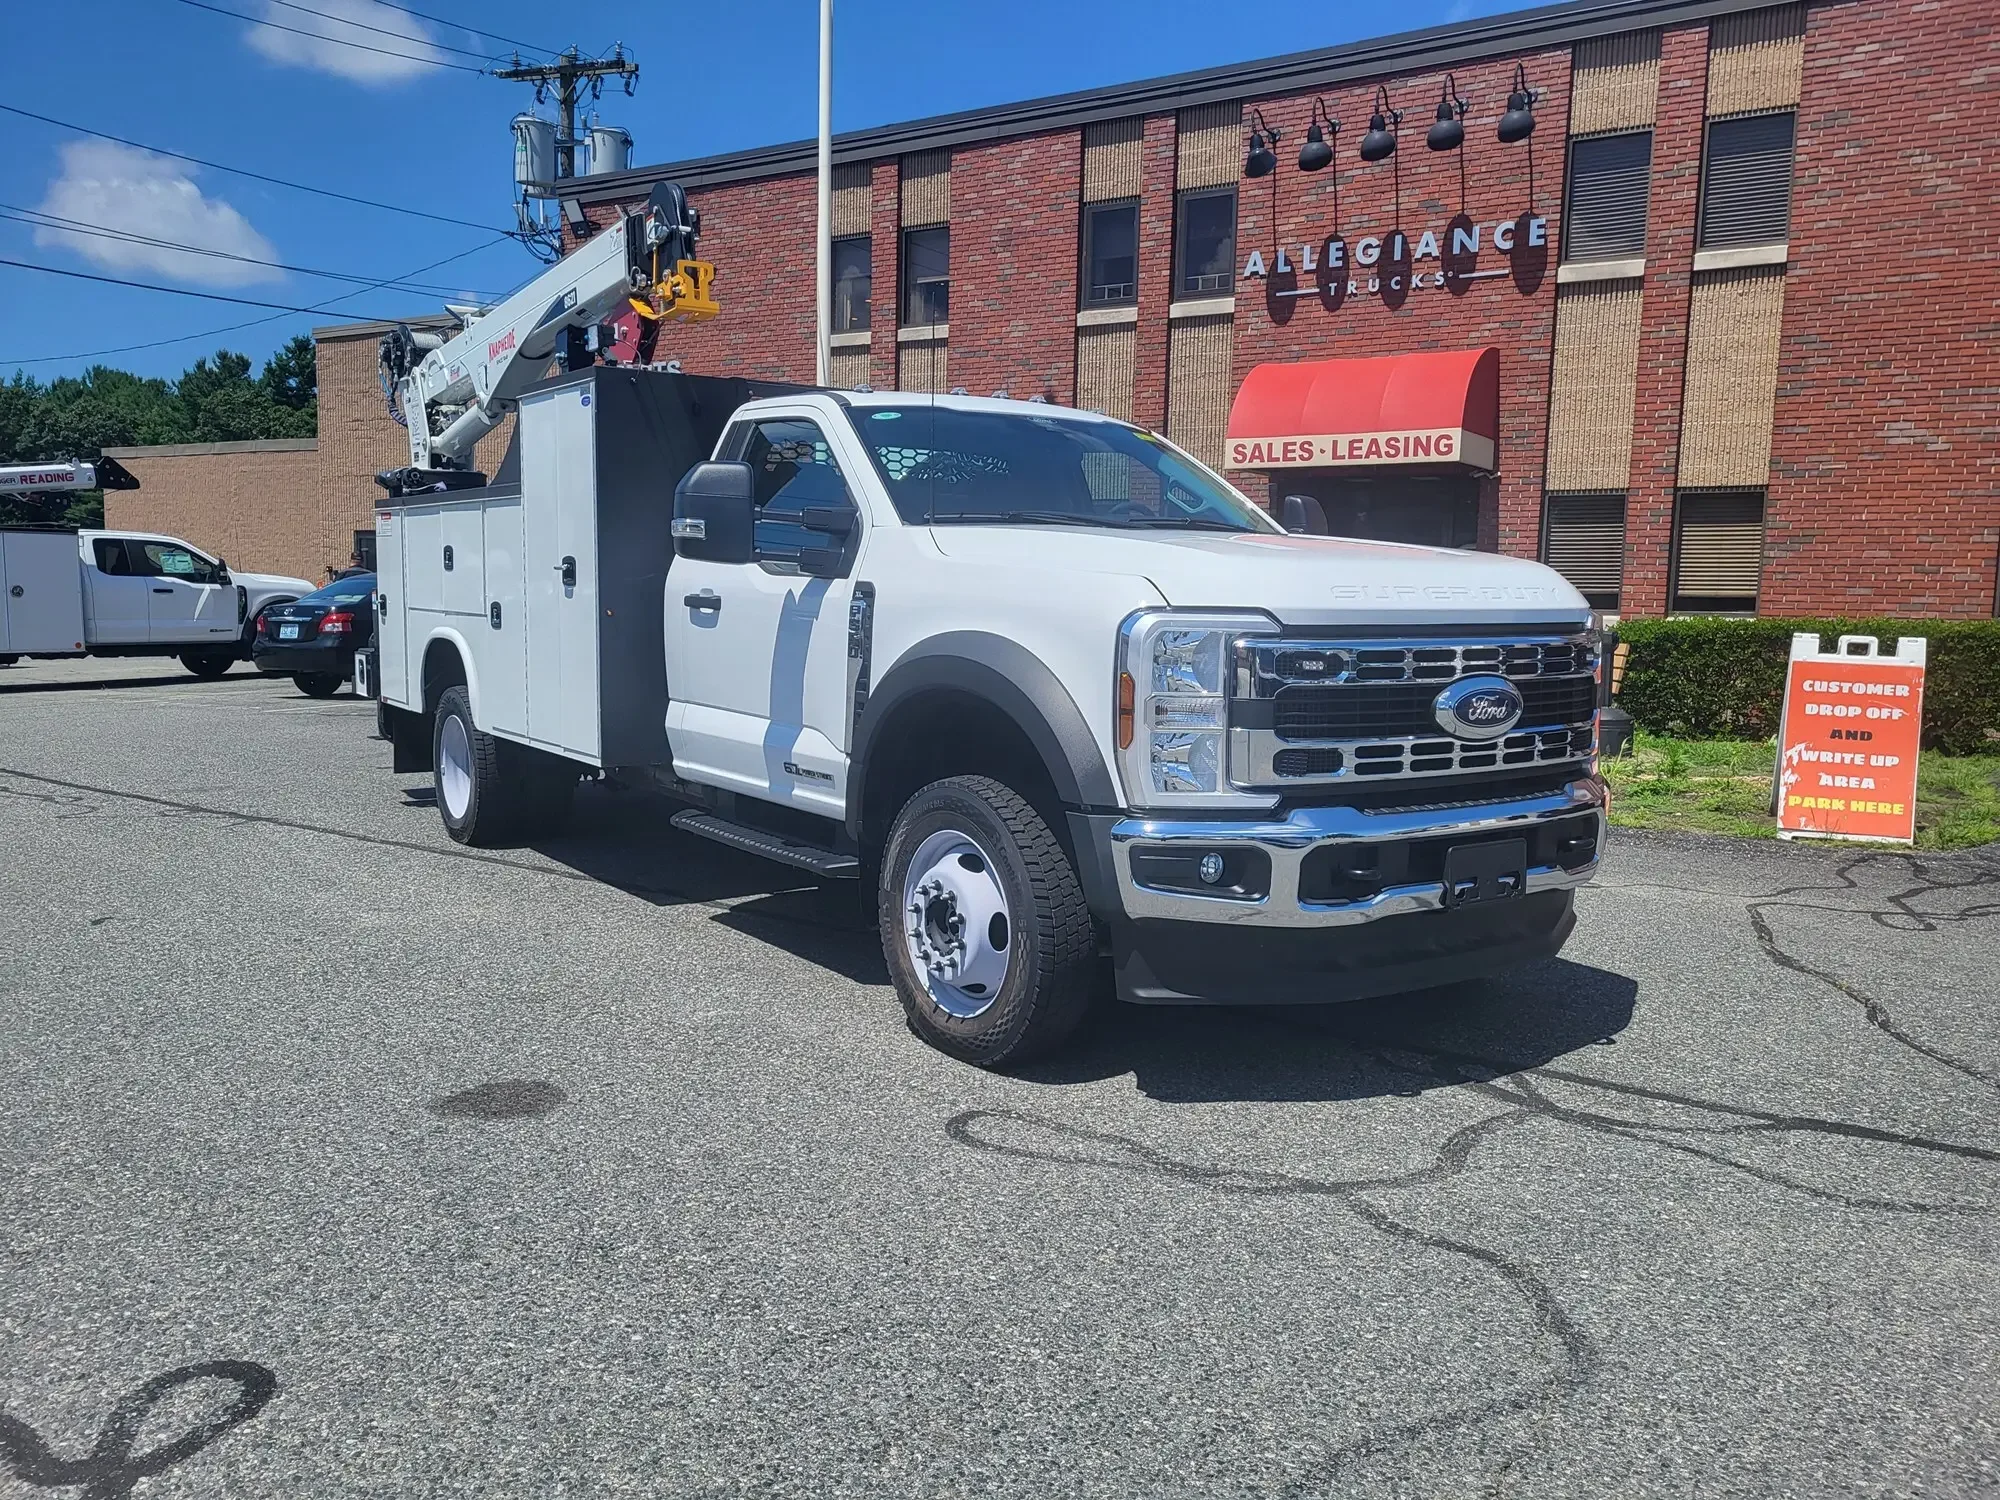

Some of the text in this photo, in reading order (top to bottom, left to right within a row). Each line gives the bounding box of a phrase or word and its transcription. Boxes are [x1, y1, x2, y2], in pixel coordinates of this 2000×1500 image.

[1243, 217, 1546, 278] ALLEGIANCE
[1232, 434, 1454, 464] SALES LEASING
[20, 472, 75, 485] READING
[1330, 585, 1478, 602] SUPER
[1802, 679, 1910, 697] CUSTOMER
[1468, 694, 1508, 721] Ford
[1805, 703, 1904, 720] DROP OFF
[1829, 729, 1873, 741] AND
[1801, 750, 1900, 767] WRITE UP
[1818, 773, 1876, 789] AREA
[1788, 795, 1905, 815] PARK HERE
